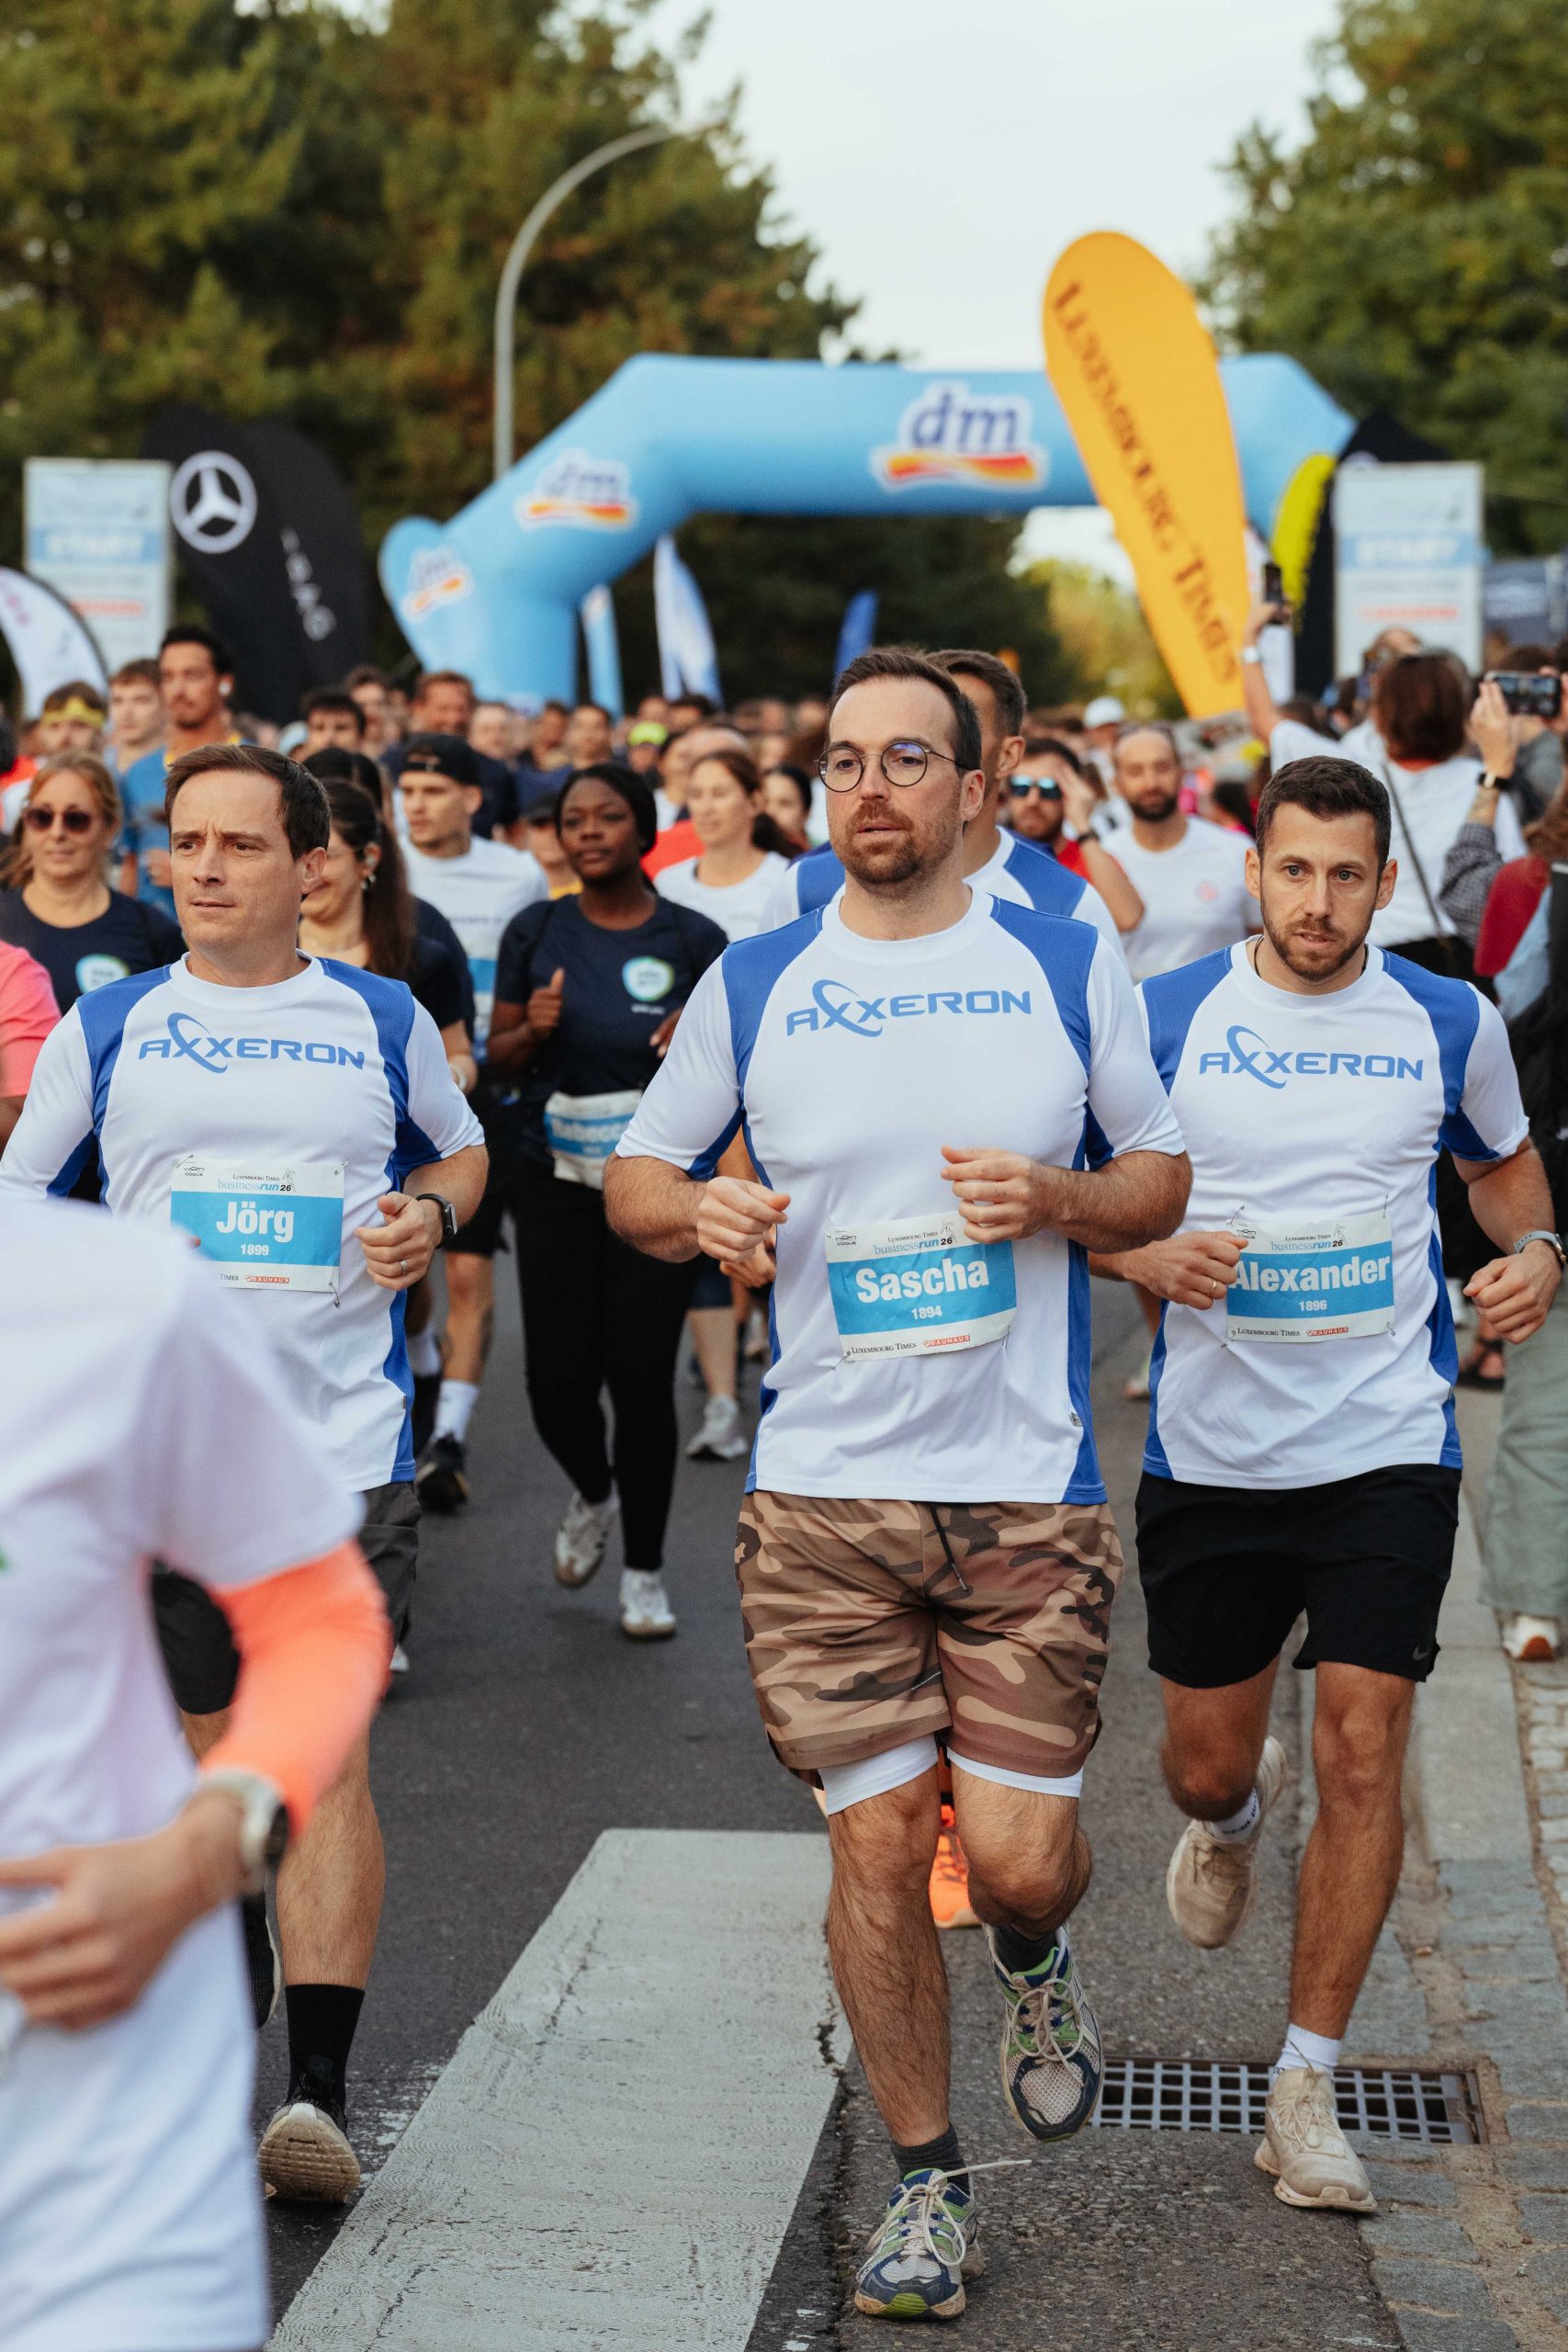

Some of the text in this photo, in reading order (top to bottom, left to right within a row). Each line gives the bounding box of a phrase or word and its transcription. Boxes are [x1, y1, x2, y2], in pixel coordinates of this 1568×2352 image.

[911, 390, 1017, 451] dm
[786, 978, 1032, 1037] AXXERON
[138, 1012, 365, 1073] AXXERON
[1199, 1025, 1424, 1089] AXXERON
[216, 1201, 295, 1243] Jörg
[941, 1237, 953, 1246] 26
[241, 1244, 269, 1256] 1899
[252, 1275, 290, 1283] BAUHAUS
[855, 1258, 989, 1303] Sascha
[1228, 1256, 1391, 1293] Alexander
[1299, 1299, 1327, 1312] 1896
[911, 1306, 942, 1320] 1894
[1237, 1328, 1279, 1336] LUXEMBOURG
[1313, 1327, 1348, 1336] BAUHAUS
[931, 1335, 970, 1346] BAUHAUS
[852, 1342, 917, 1354] LUXEMBOURG TIMES
